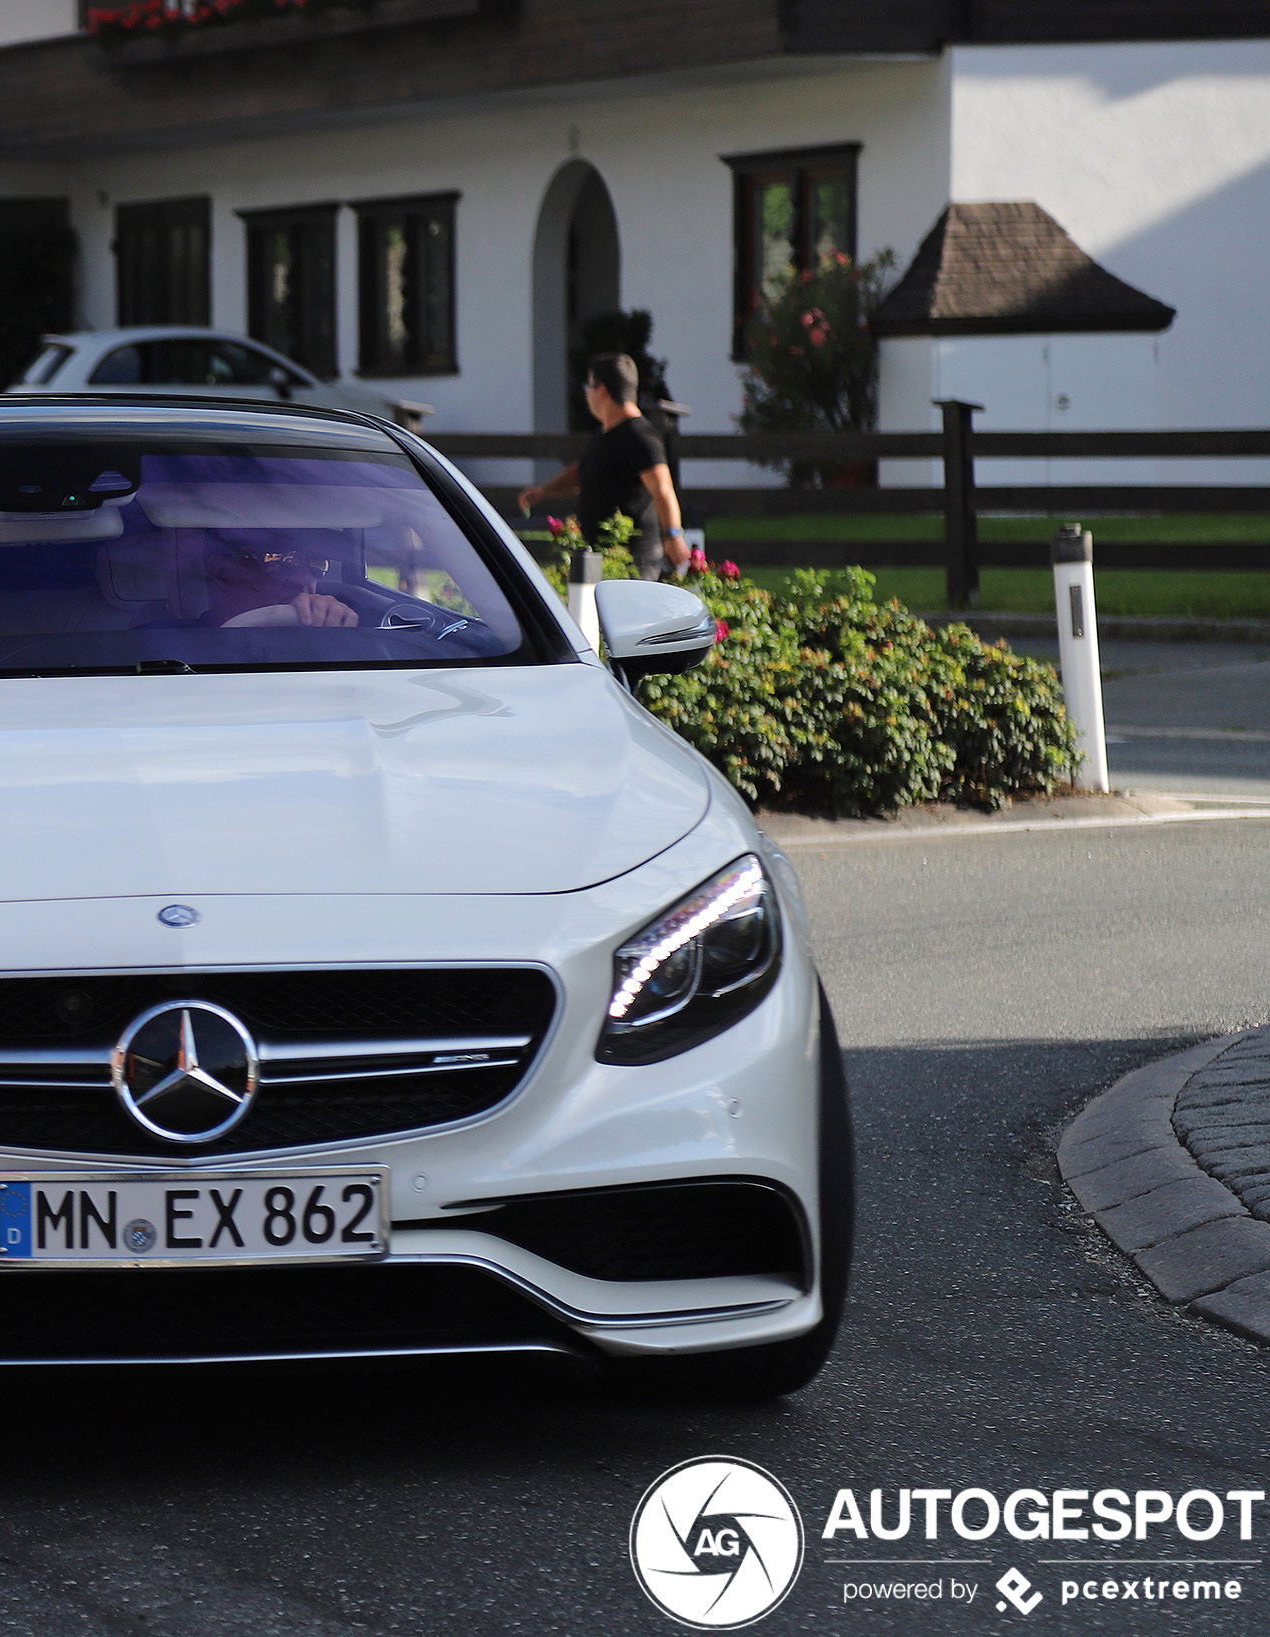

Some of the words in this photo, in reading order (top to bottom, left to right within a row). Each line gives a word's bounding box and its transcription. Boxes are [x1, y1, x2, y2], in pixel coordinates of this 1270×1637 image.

[7, 1228, 21, 1244] D
[37, 1191, 116, 1248] MN
[166, 1189, 244, 1248] EX
[264, 1185, 374, 1246] 862
